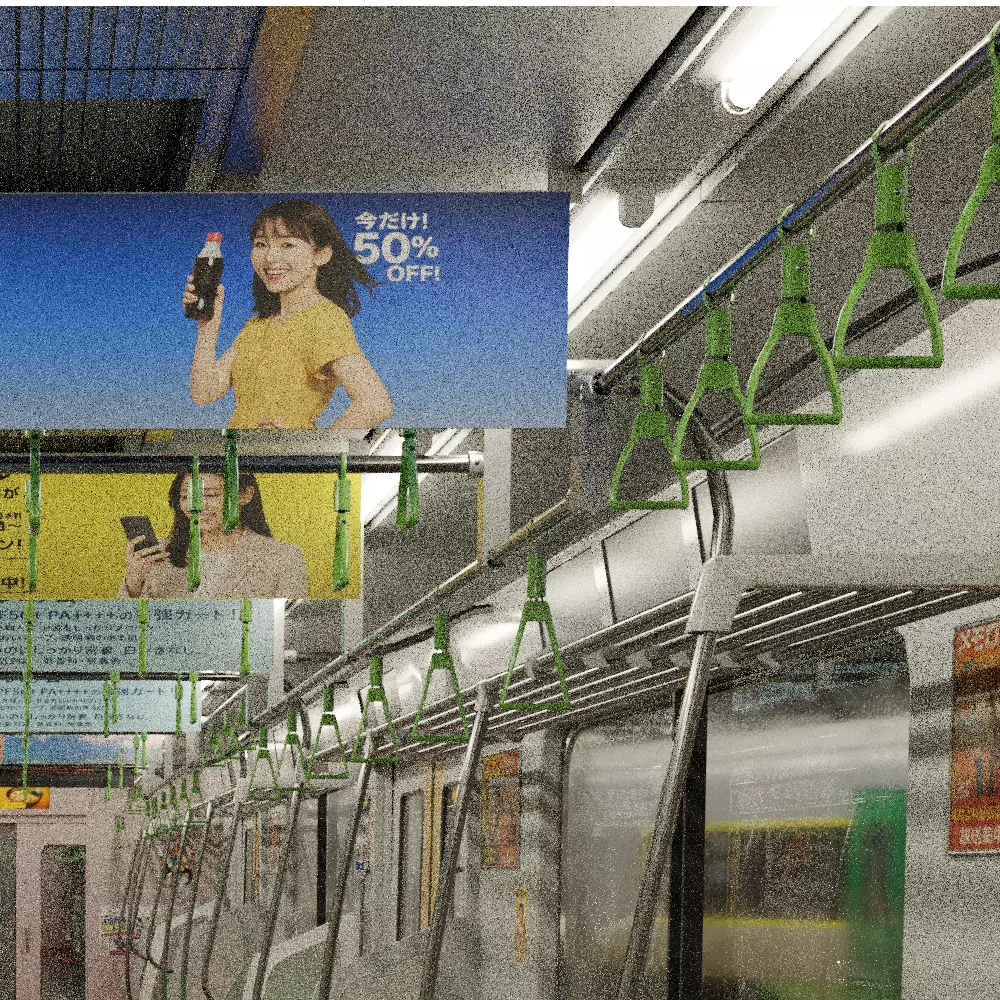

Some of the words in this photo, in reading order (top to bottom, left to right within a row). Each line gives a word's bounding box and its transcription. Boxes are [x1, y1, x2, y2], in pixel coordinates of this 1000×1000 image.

[354, 211, 429, 230] 今だけ!
[353, 231, 439, 265] 50%
[386, 264, 441, 282] OFF!
